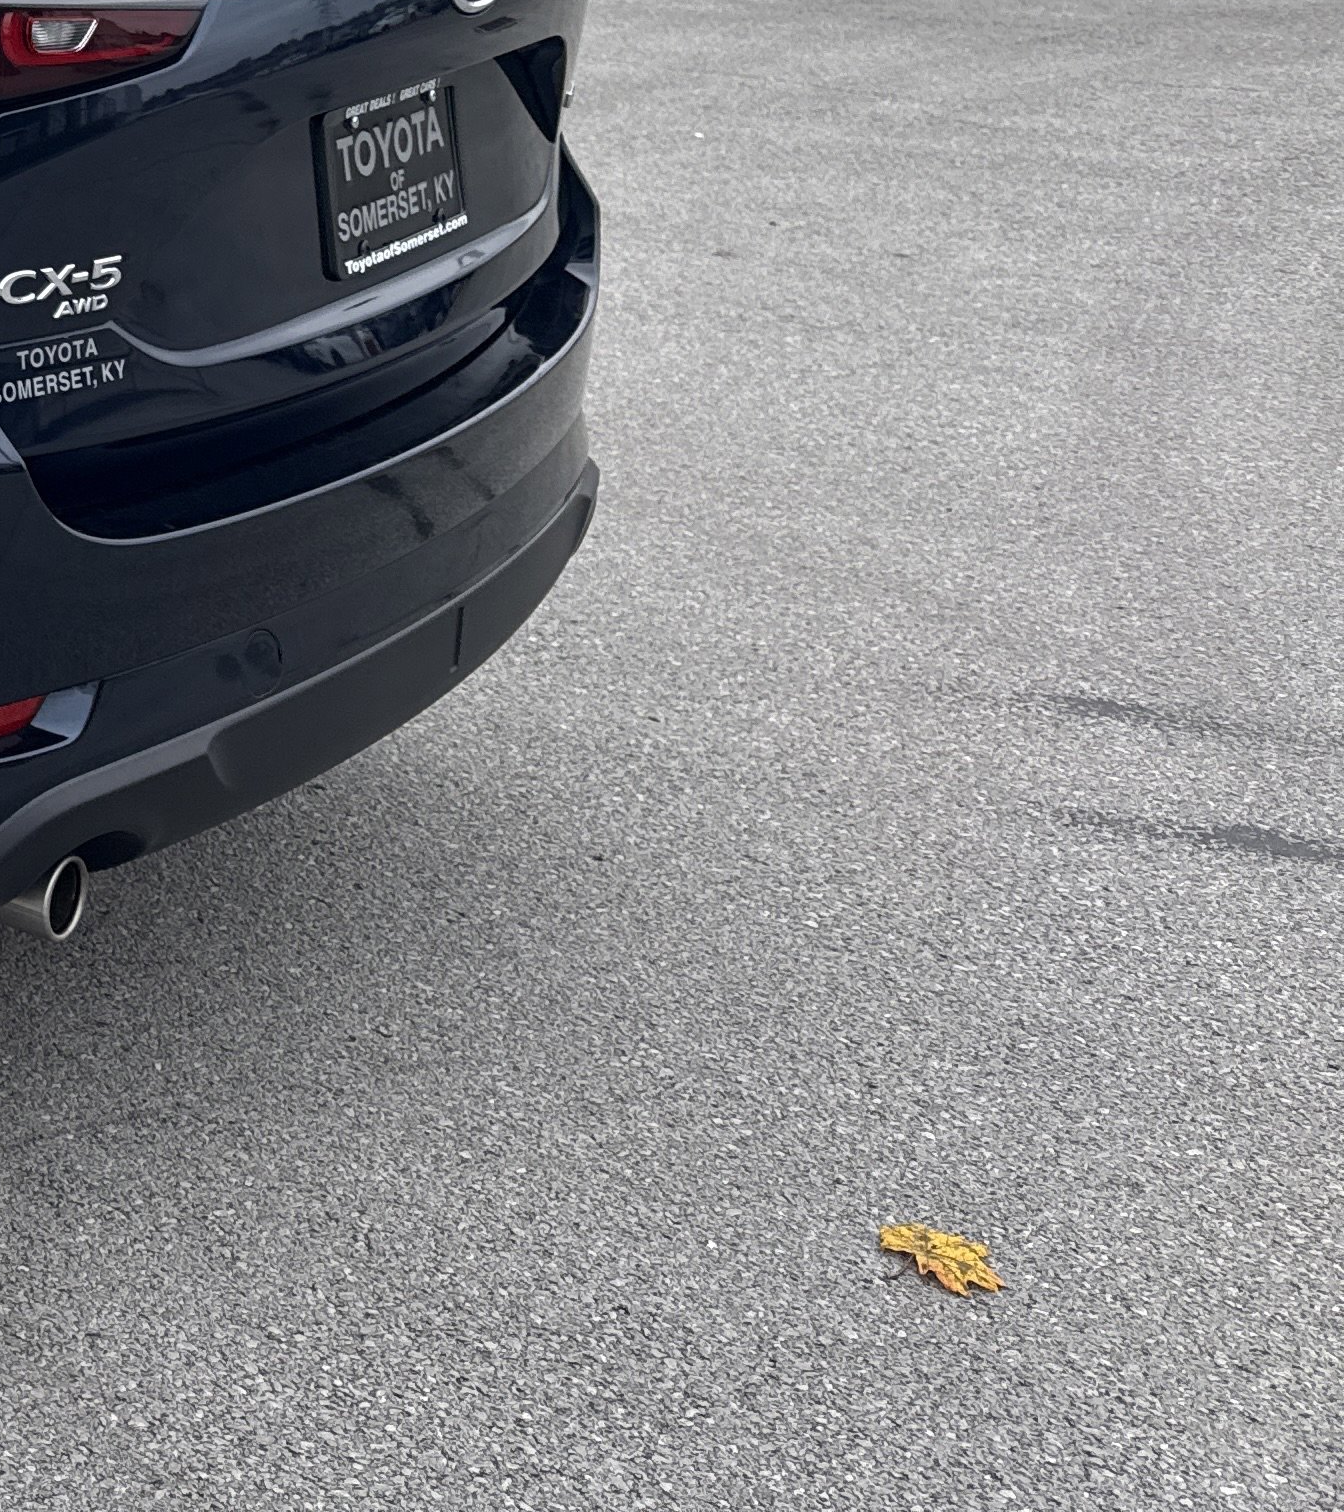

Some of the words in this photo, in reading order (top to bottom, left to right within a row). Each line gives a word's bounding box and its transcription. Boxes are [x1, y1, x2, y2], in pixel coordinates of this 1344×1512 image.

[346, 101, 369, 120] GREAT
[399, 84, 421, 101] GREAT
[336, 106, 445, 182] TOYOTA
[390, 169, 405, 191] OF
[338, 181, 432, 242] SOMERSET,
[433, 169, 454, 205] KY
[344, 214, 468, 275] ToyotaofSomerset.com
[52, 293, 109, 319] AWD
[16, 338, 99, 371] TOYOTA
[101, 359, 126, 383] KY
